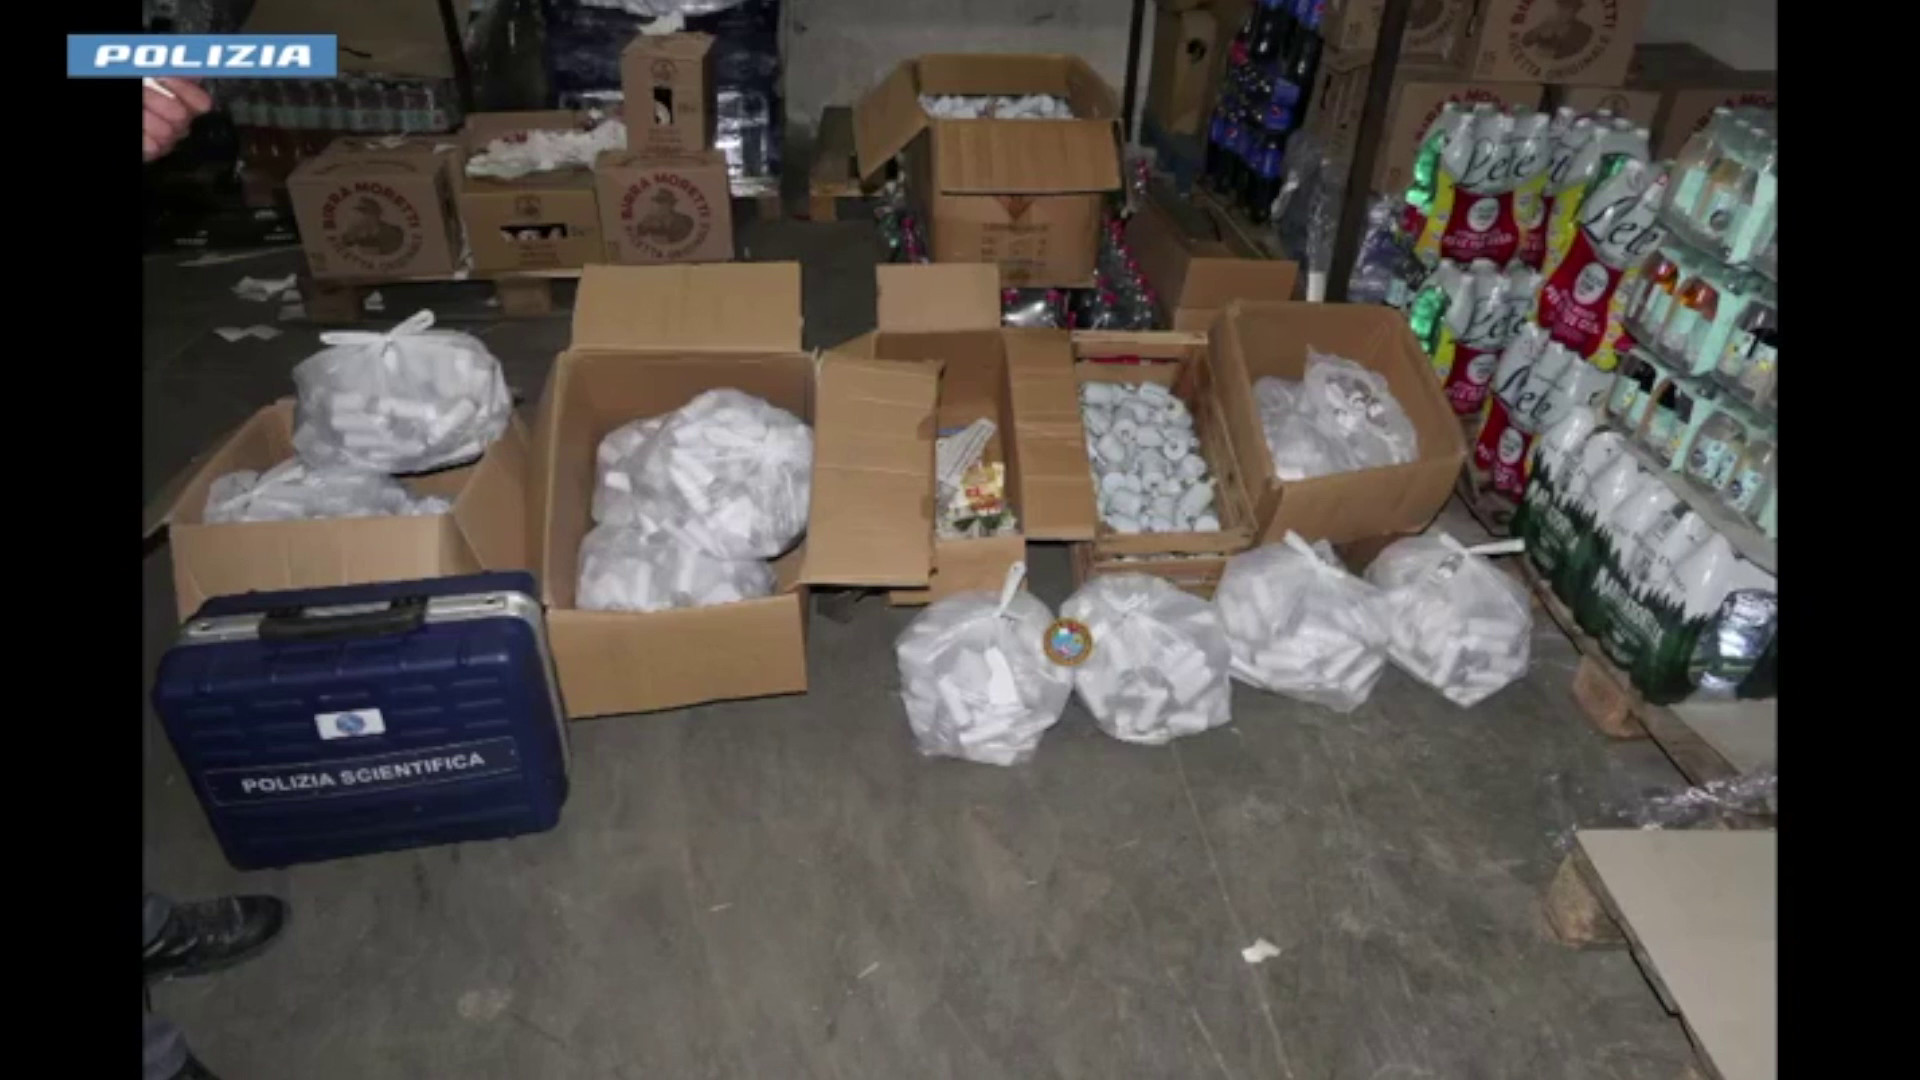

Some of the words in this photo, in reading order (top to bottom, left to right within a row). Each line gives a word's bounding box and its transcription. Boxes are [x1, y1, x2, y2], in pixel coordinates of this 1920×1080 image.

[322, 185, 352, 230] BIRRA
[354, 181, 421, 229] MORETTI
[621, 176, 651, 221] BIRRA
[653, 171, 711, 218] MORETTI
[241, 772, 336, 794] POLIZIA
[340, 751, 486, 786] SCIENTIFICA
